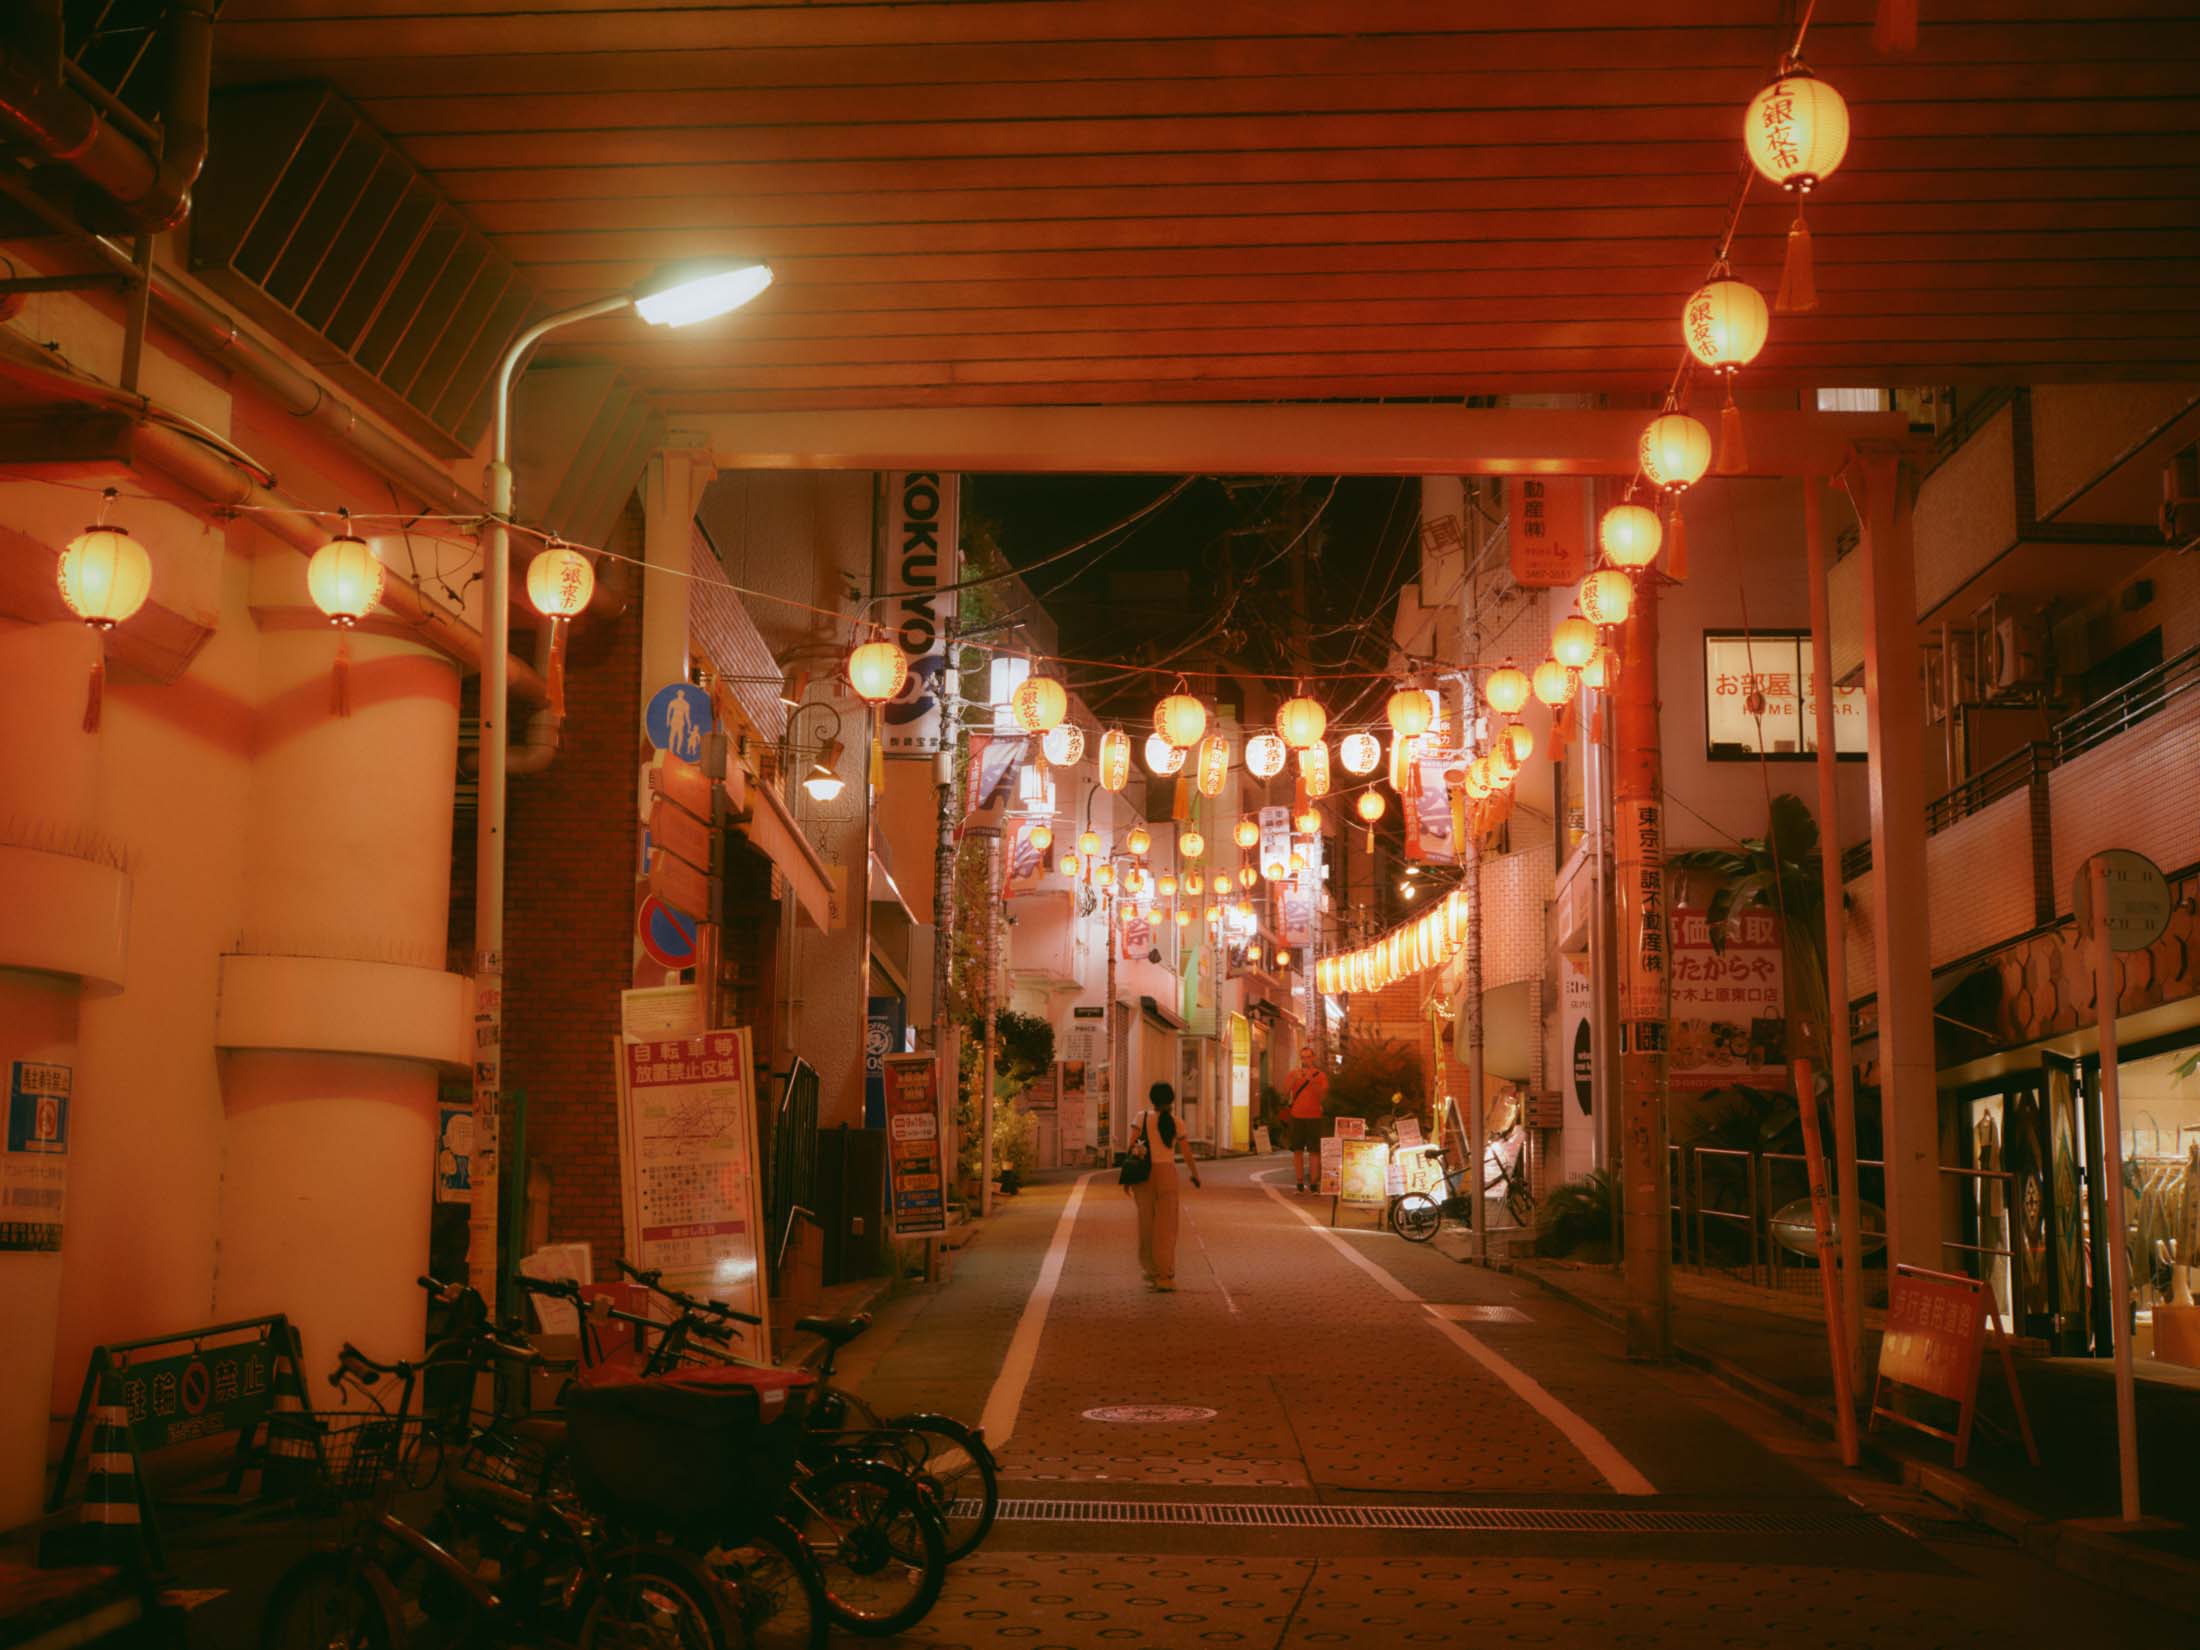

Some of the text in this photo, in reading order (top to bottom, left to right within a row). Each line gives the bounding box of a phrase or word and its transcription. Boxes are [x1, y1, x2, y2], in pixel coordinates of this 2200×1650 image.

[1762, 84, 1799, 168] 上銀夜市
[1715, 672, 1792, 697] お部屋
[1743, 704, 1860, 715] HME SAR.
[1672, 955, 1776, 982] たからや
[635, 1057, 735, 1084] 放置禁止区域
